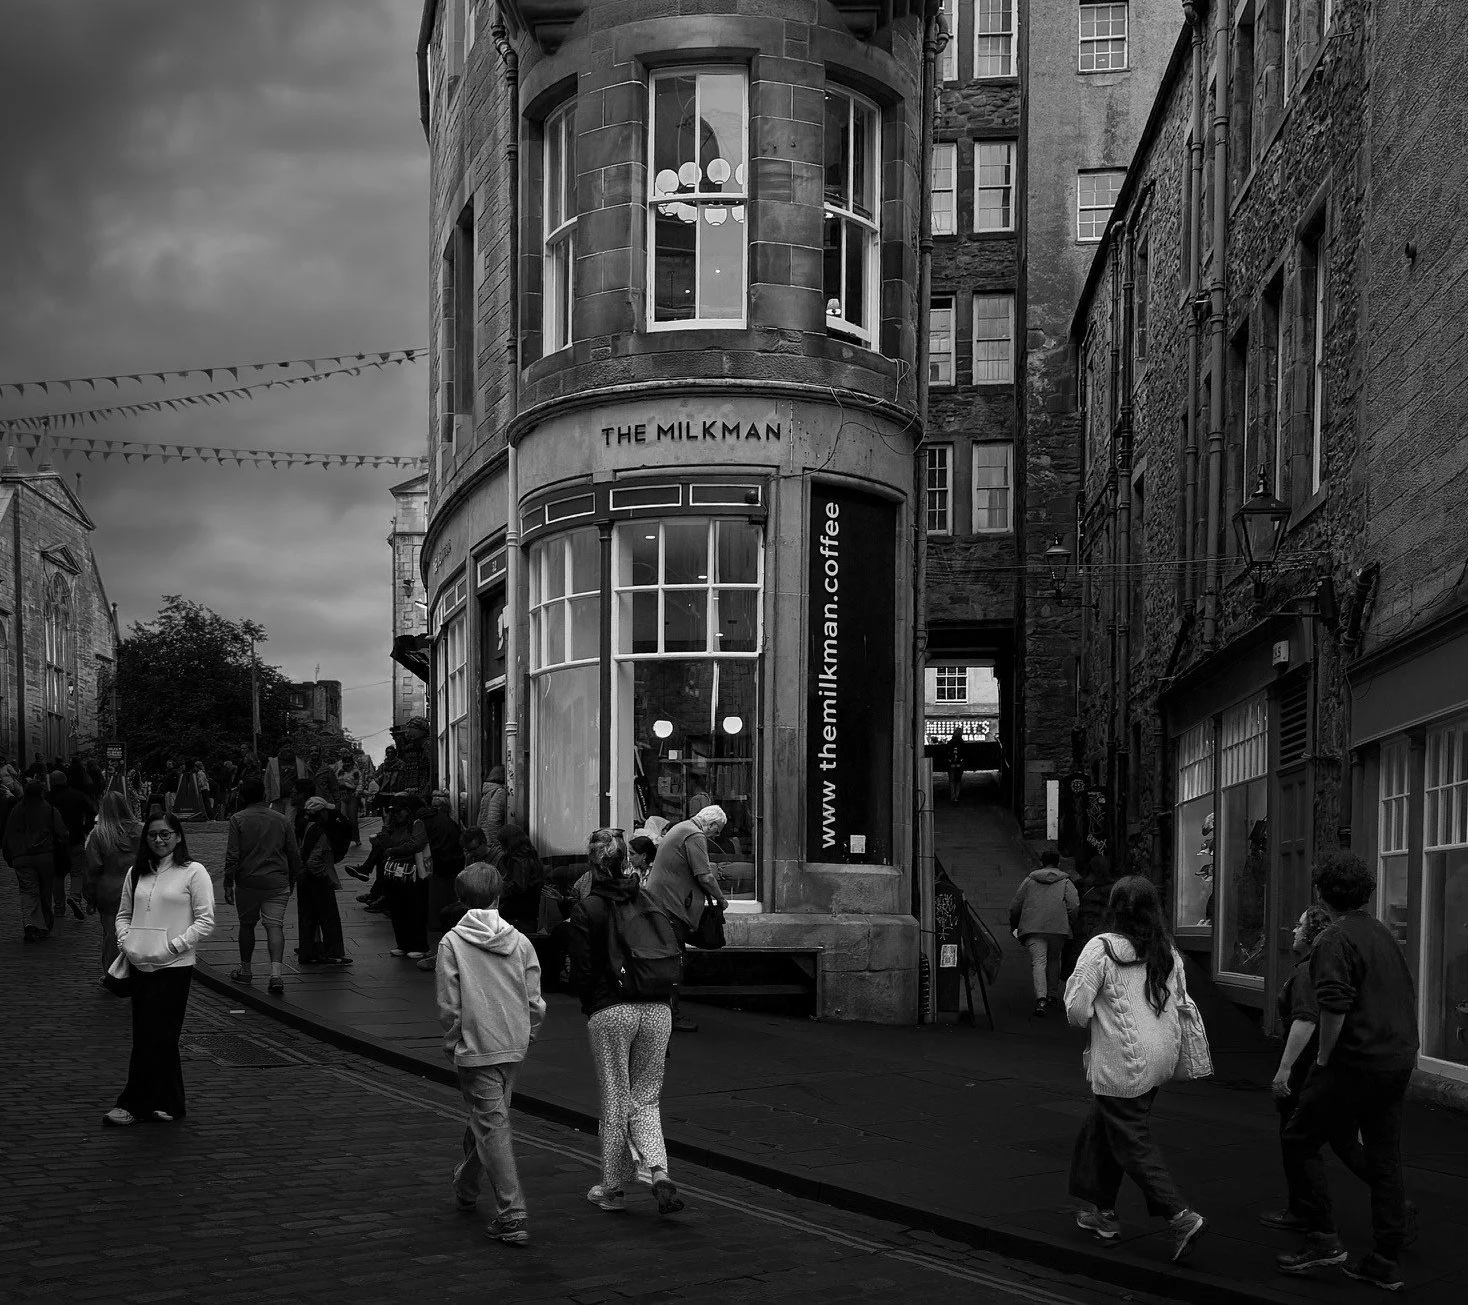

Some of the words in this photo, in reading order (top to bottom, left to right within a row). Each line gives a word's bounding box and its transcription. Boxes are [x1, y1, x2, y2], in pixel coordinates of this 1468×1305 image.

[601, 423, 647, 446] THE
[657, 420, 781, 441] MILKMAN
[817, 501, 840, 771] themilkman.coffee
[820, 780, 837, 849] www
